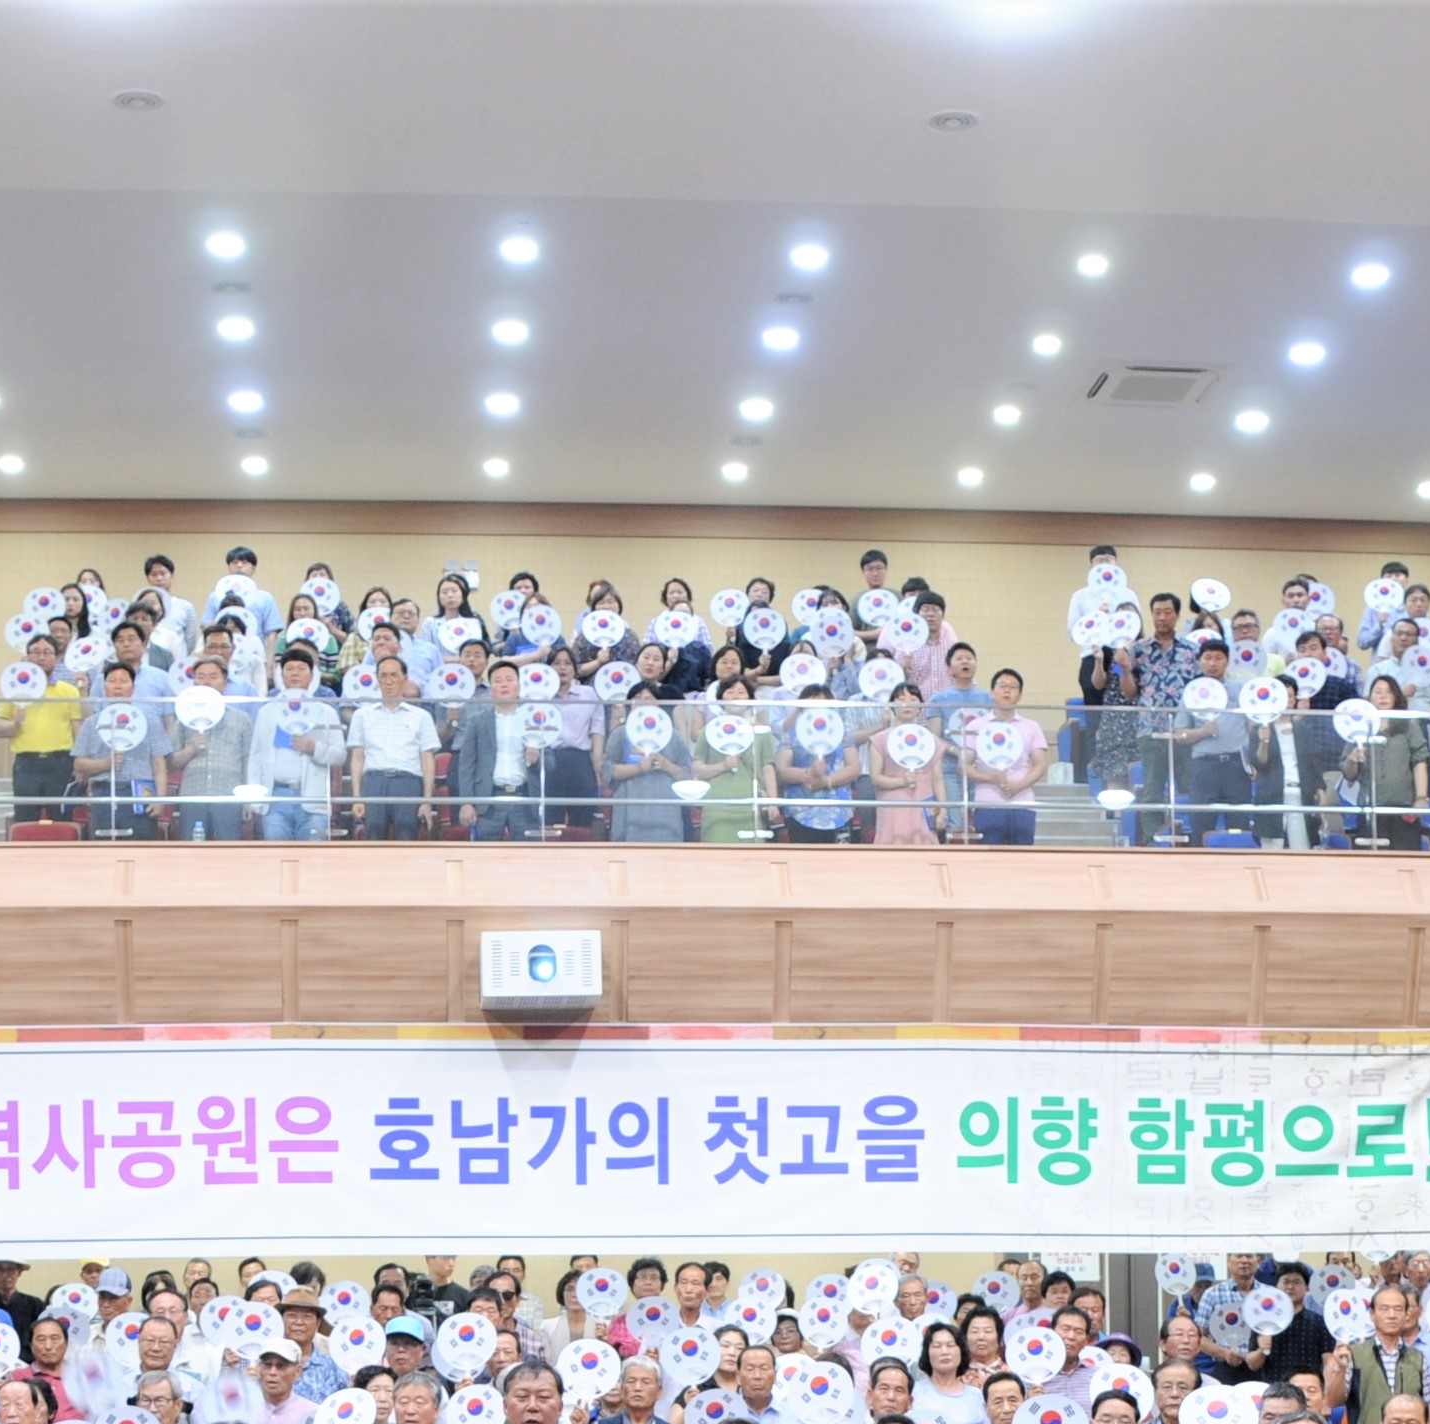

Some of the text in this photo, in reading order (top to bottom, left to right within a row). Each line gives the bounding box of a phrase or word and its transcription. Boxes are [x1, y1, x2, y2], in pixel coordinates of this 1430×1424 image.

[368, 1096, 671, 1187] 호남가의
[703, 1094, 926, 1186] 첫고을
[955, 1095, 1100, 1187] 의향
